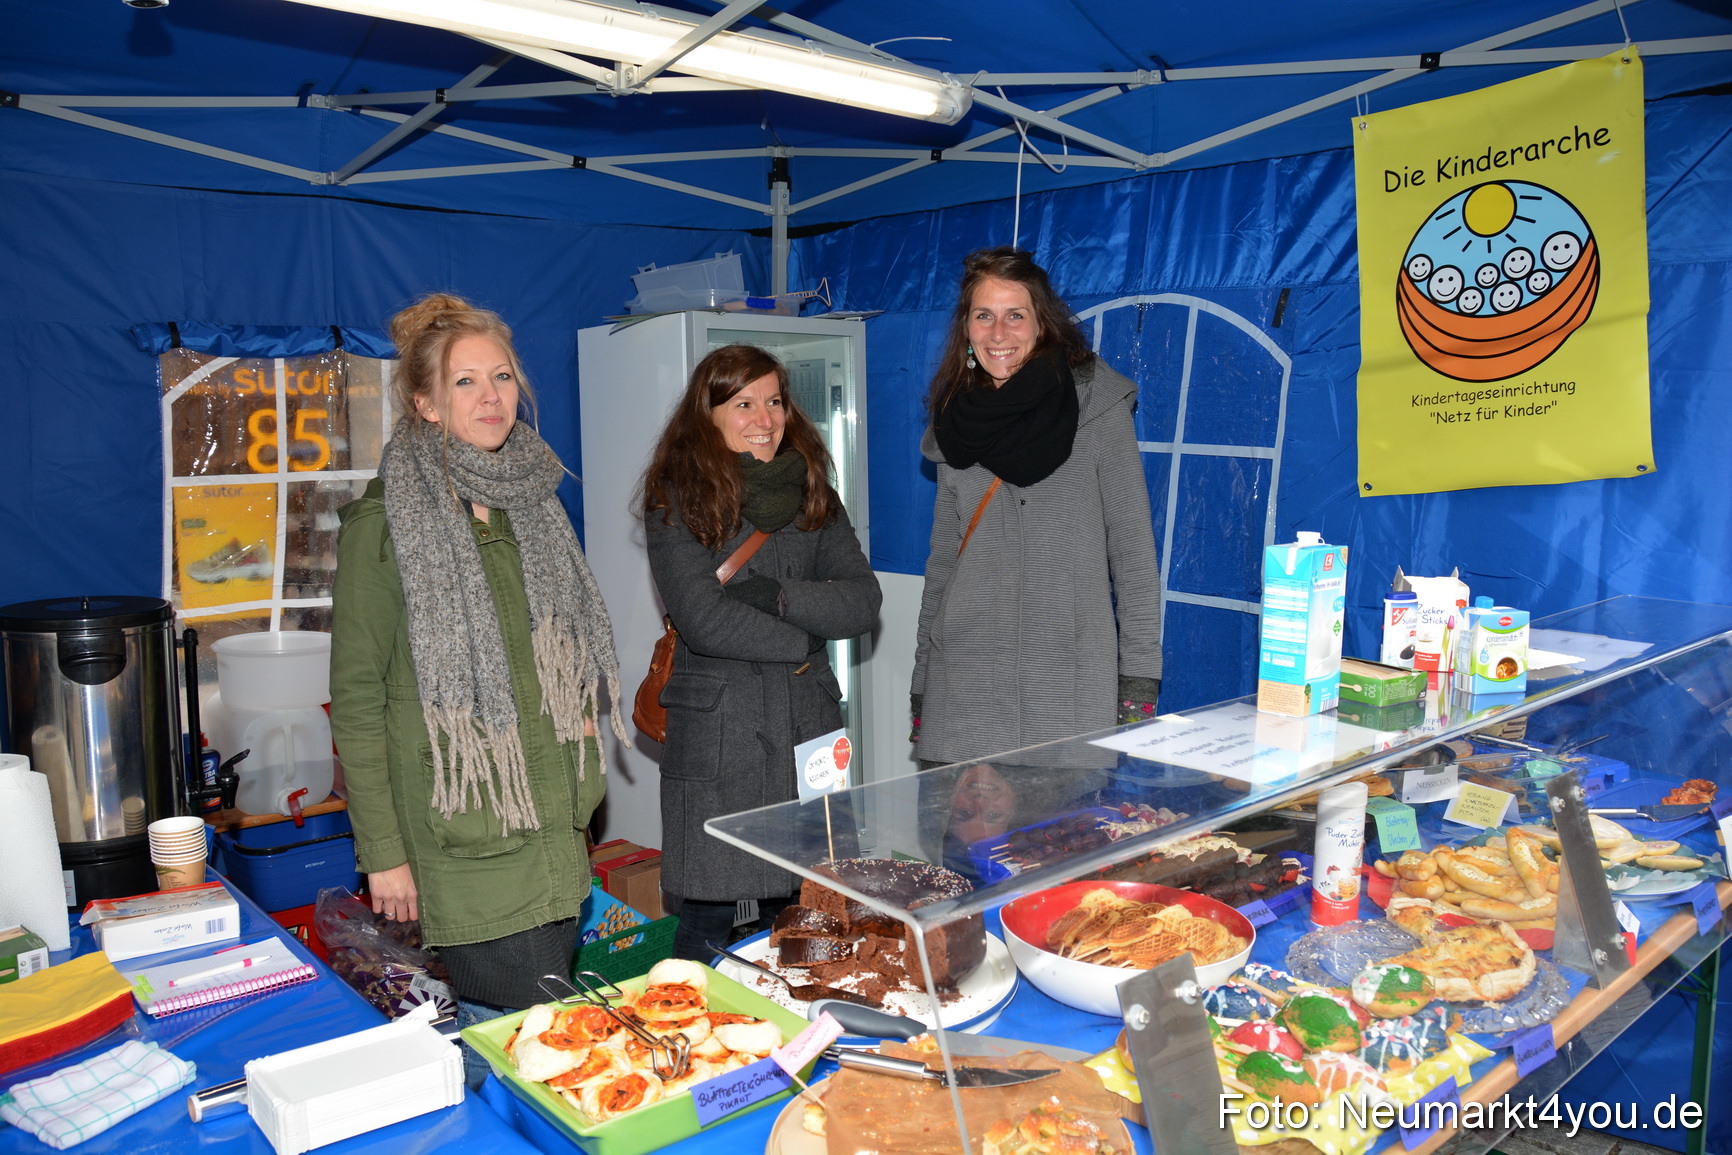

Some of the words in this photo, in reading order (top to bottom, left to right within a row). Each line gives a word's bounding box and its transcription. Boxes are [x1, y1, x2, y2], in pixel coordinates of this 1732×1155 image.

[1384, 166, 1425, 193] Die
[1437, 125, 1611, 182] Kinderarche
[232, 364, 338, 396] sutor
[1411, 381, 1576, 408] Kindertageseinrichtung
[1430, 410, 1471, 424] "Netz
[1476, 407, 1499, 421] für
[1504, 400, 1558, 418] Kinder"
[247, 408, 331, 474] 85
[202, 486, 243, 498] sutor
[1417, 603, 1445, 616] Zucker
[1421, 614, 1448, 625] Sticks
[1326, 826, 1349, 839] Puder
[718, 1093, 752, 1112] PIKANT
